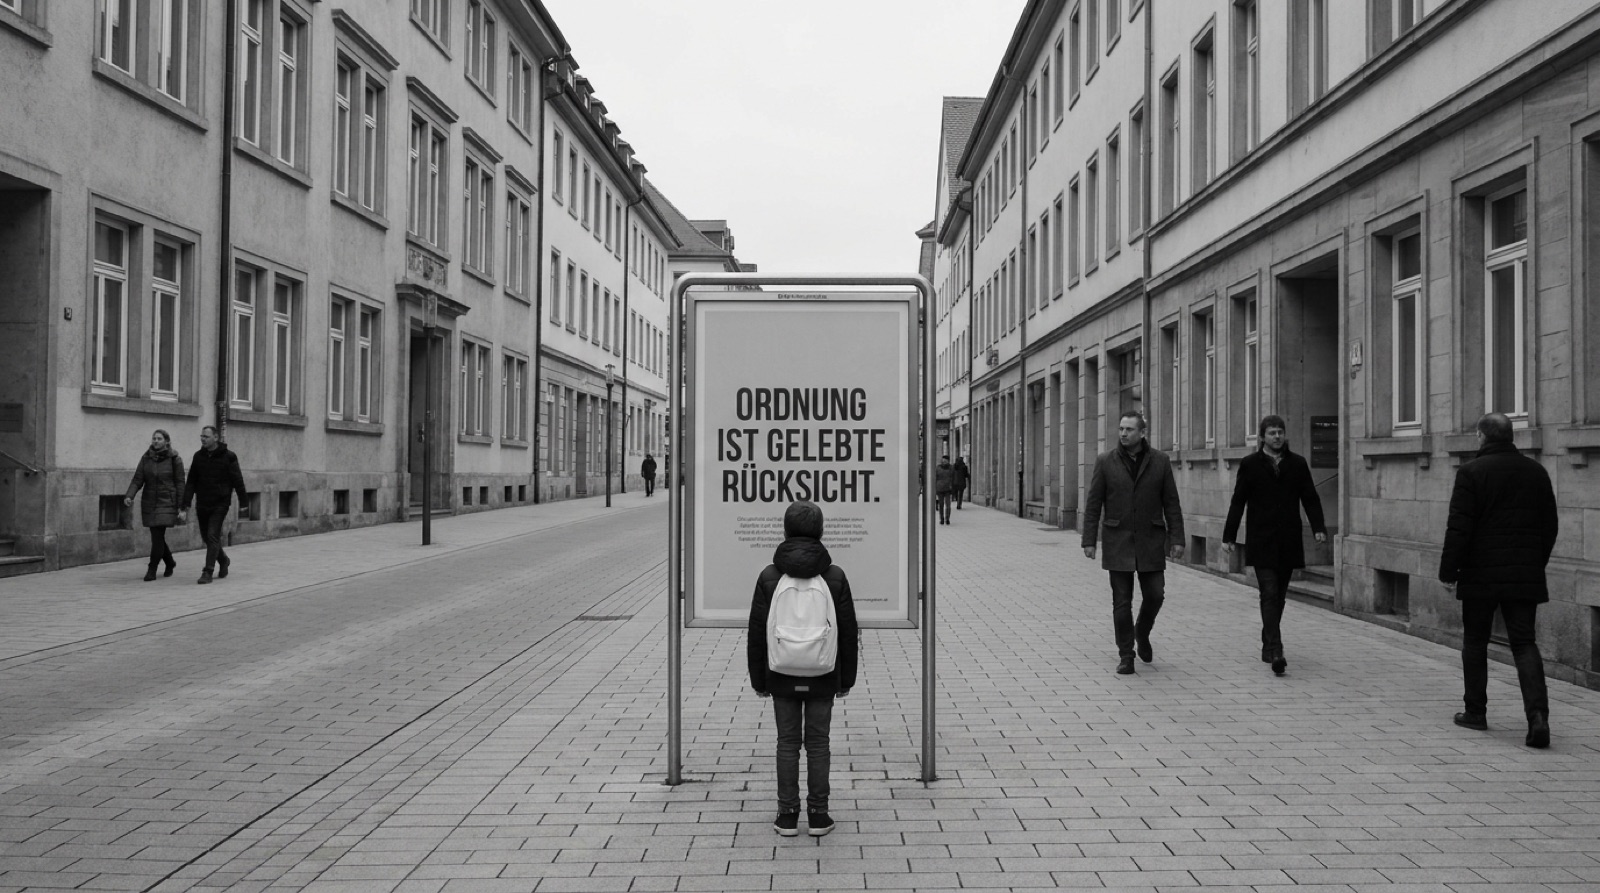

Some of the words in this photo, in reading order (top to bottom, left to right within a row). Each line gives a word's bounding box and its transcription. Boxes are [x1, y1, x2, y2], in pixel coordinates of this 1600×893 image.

[736, 387, 867, 421] ORDNUNG
[718, 428, 759, 462] IST
[767, 428, 886, 462] GELEBTE
[722, 463, 880, 503] RÜCKSICHT.
